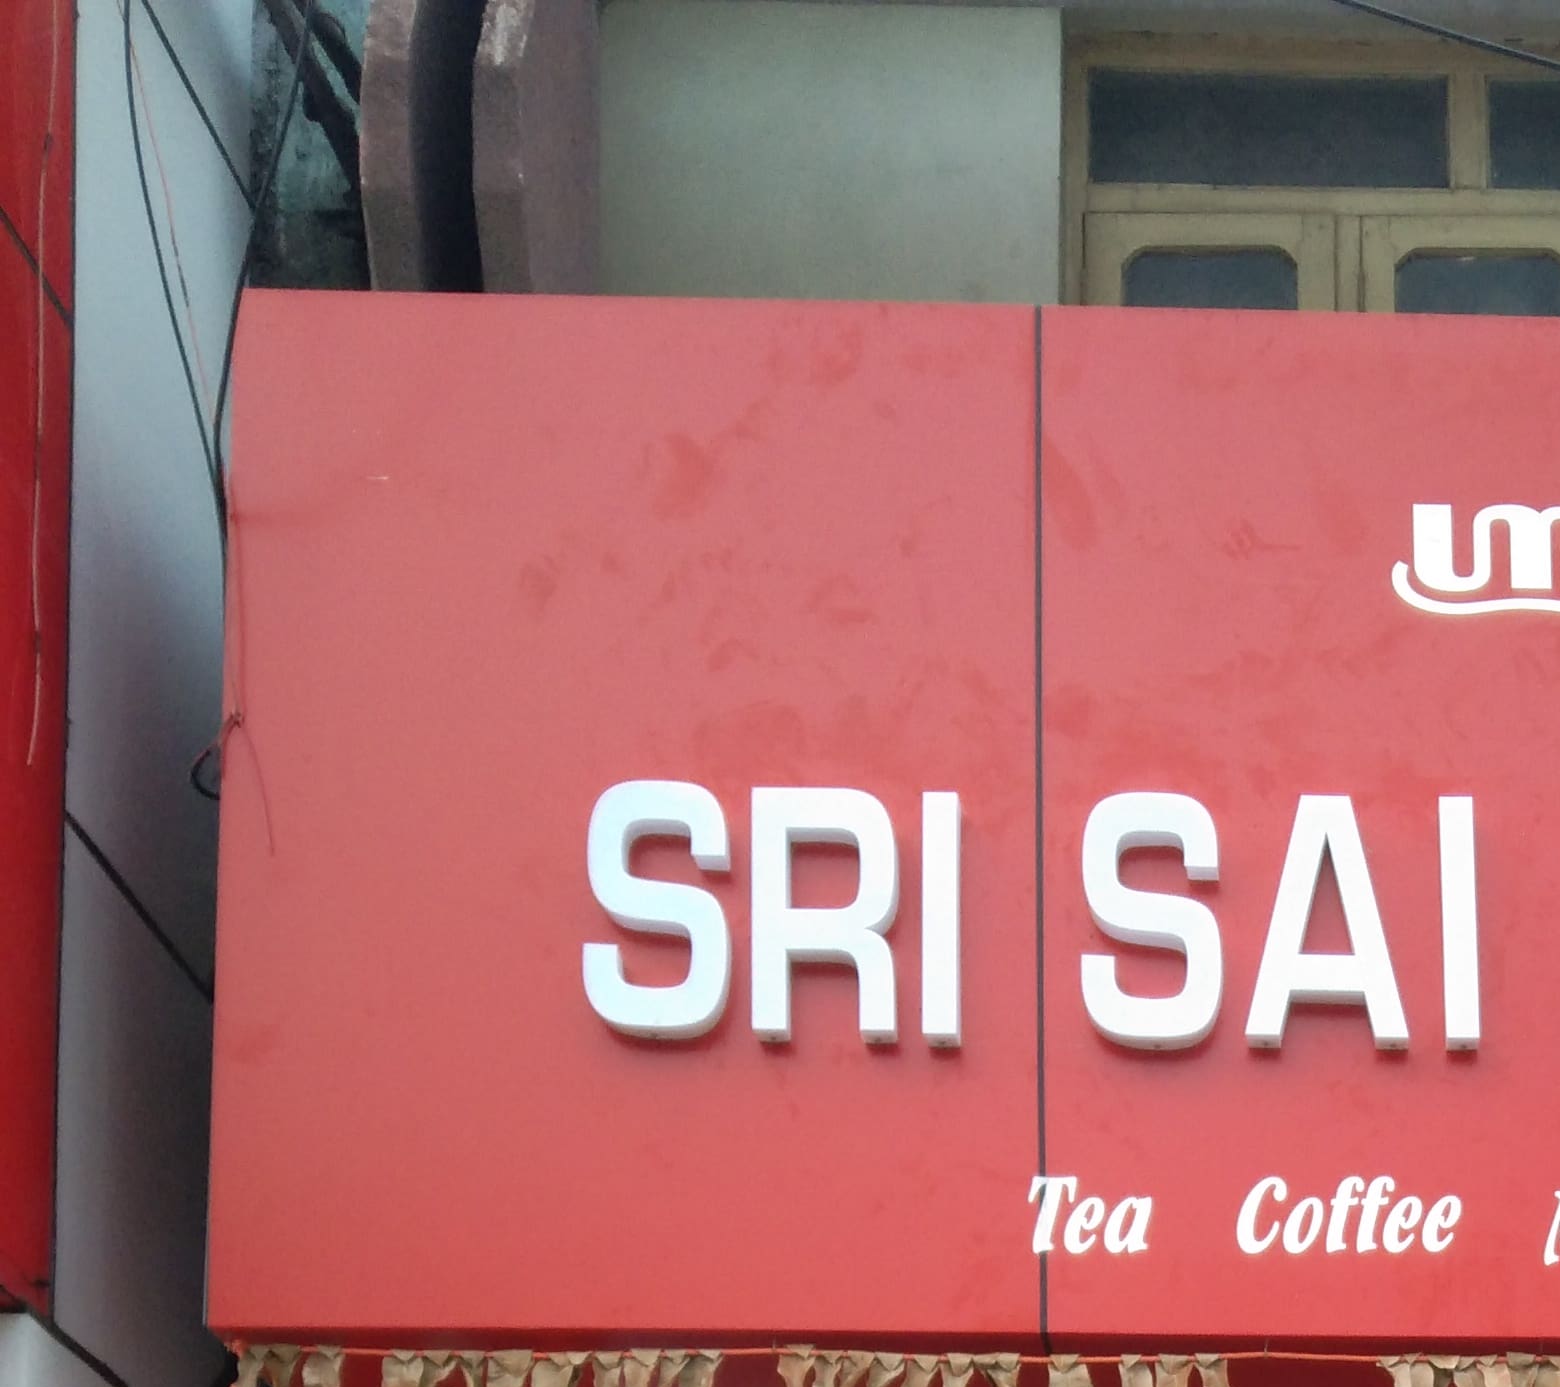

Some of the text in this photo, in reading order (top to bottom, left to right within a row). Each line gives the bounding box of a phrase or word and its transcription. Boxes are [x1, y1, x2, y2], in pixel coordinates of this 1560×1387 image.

[580, 780, 963, 1046] SRI
[1080, 790, 1482, 1051] SAI
[1027, 1174, 1155, 1257] Tea
[1235, 1175, 1463, 1256] Coffee
